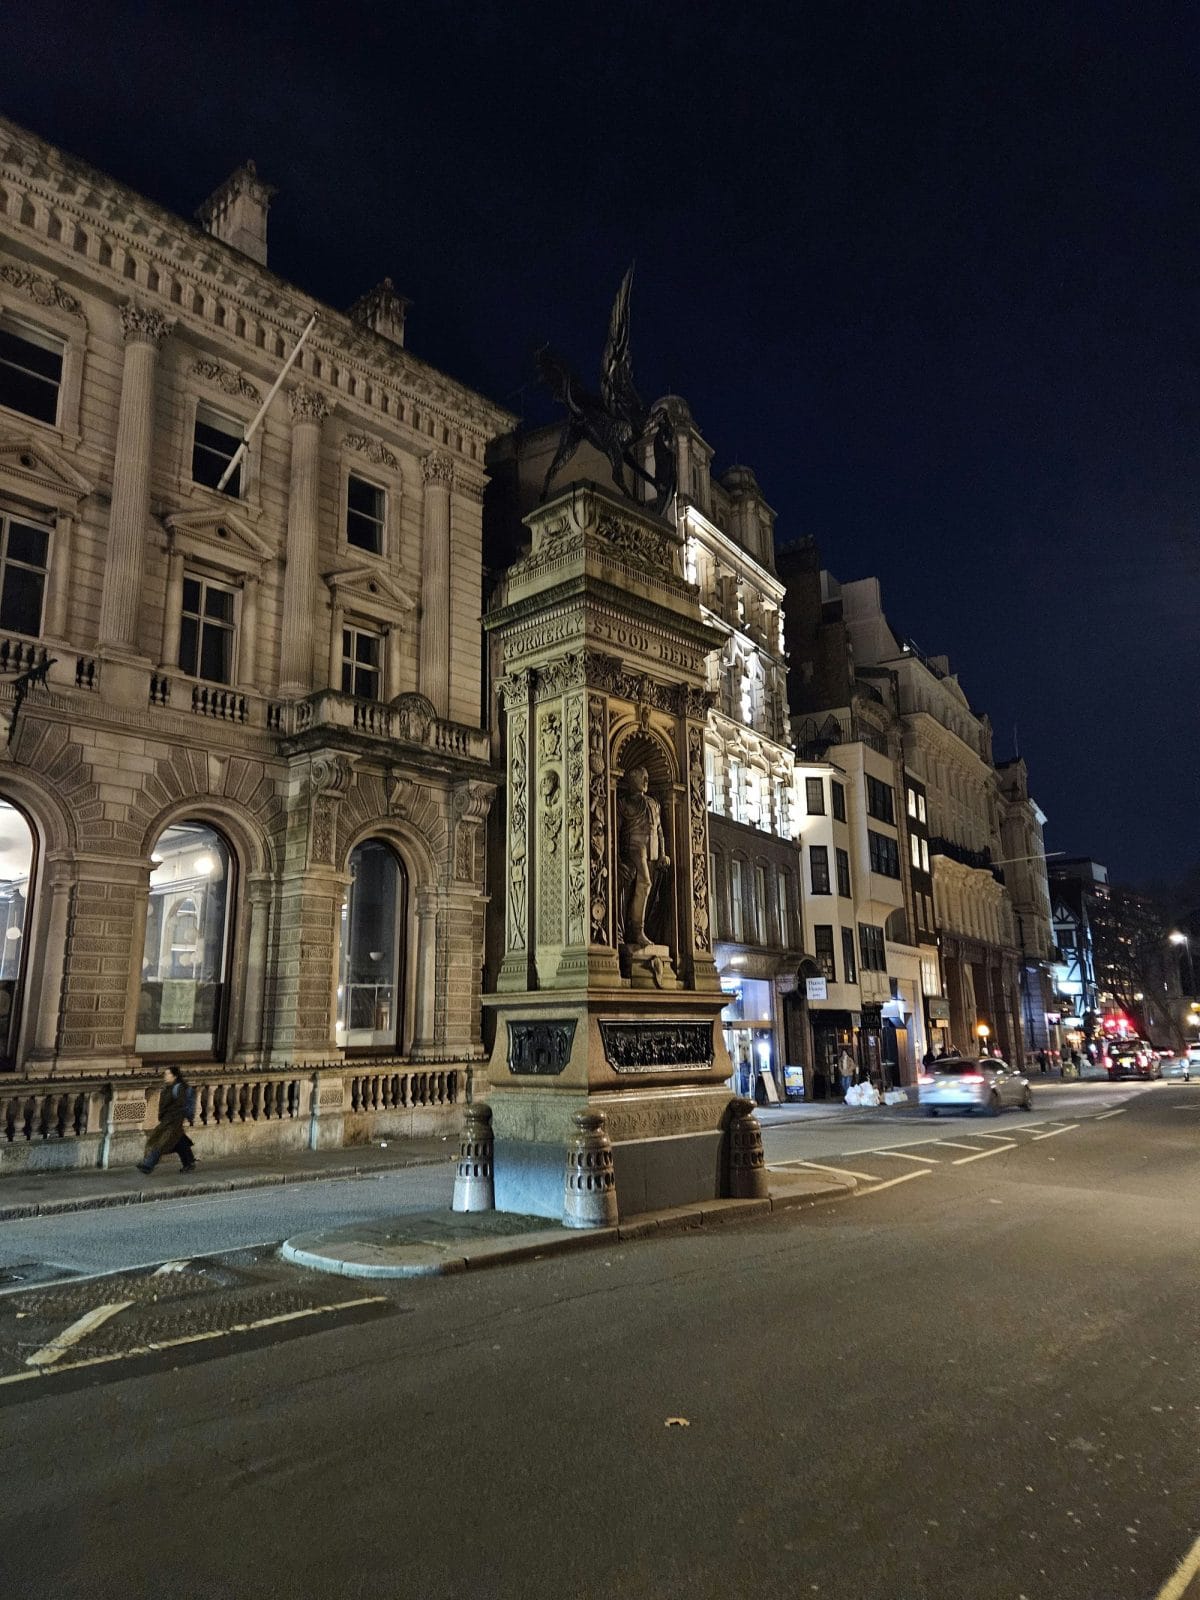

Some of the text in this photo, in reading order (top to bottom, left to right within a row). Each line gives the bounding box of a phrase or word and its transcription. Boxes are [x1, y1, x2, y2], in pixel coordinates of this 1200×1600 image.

[508, 617, 583, 657] FORMERLY
[593, 621, 699, 671] STOOD HERE
